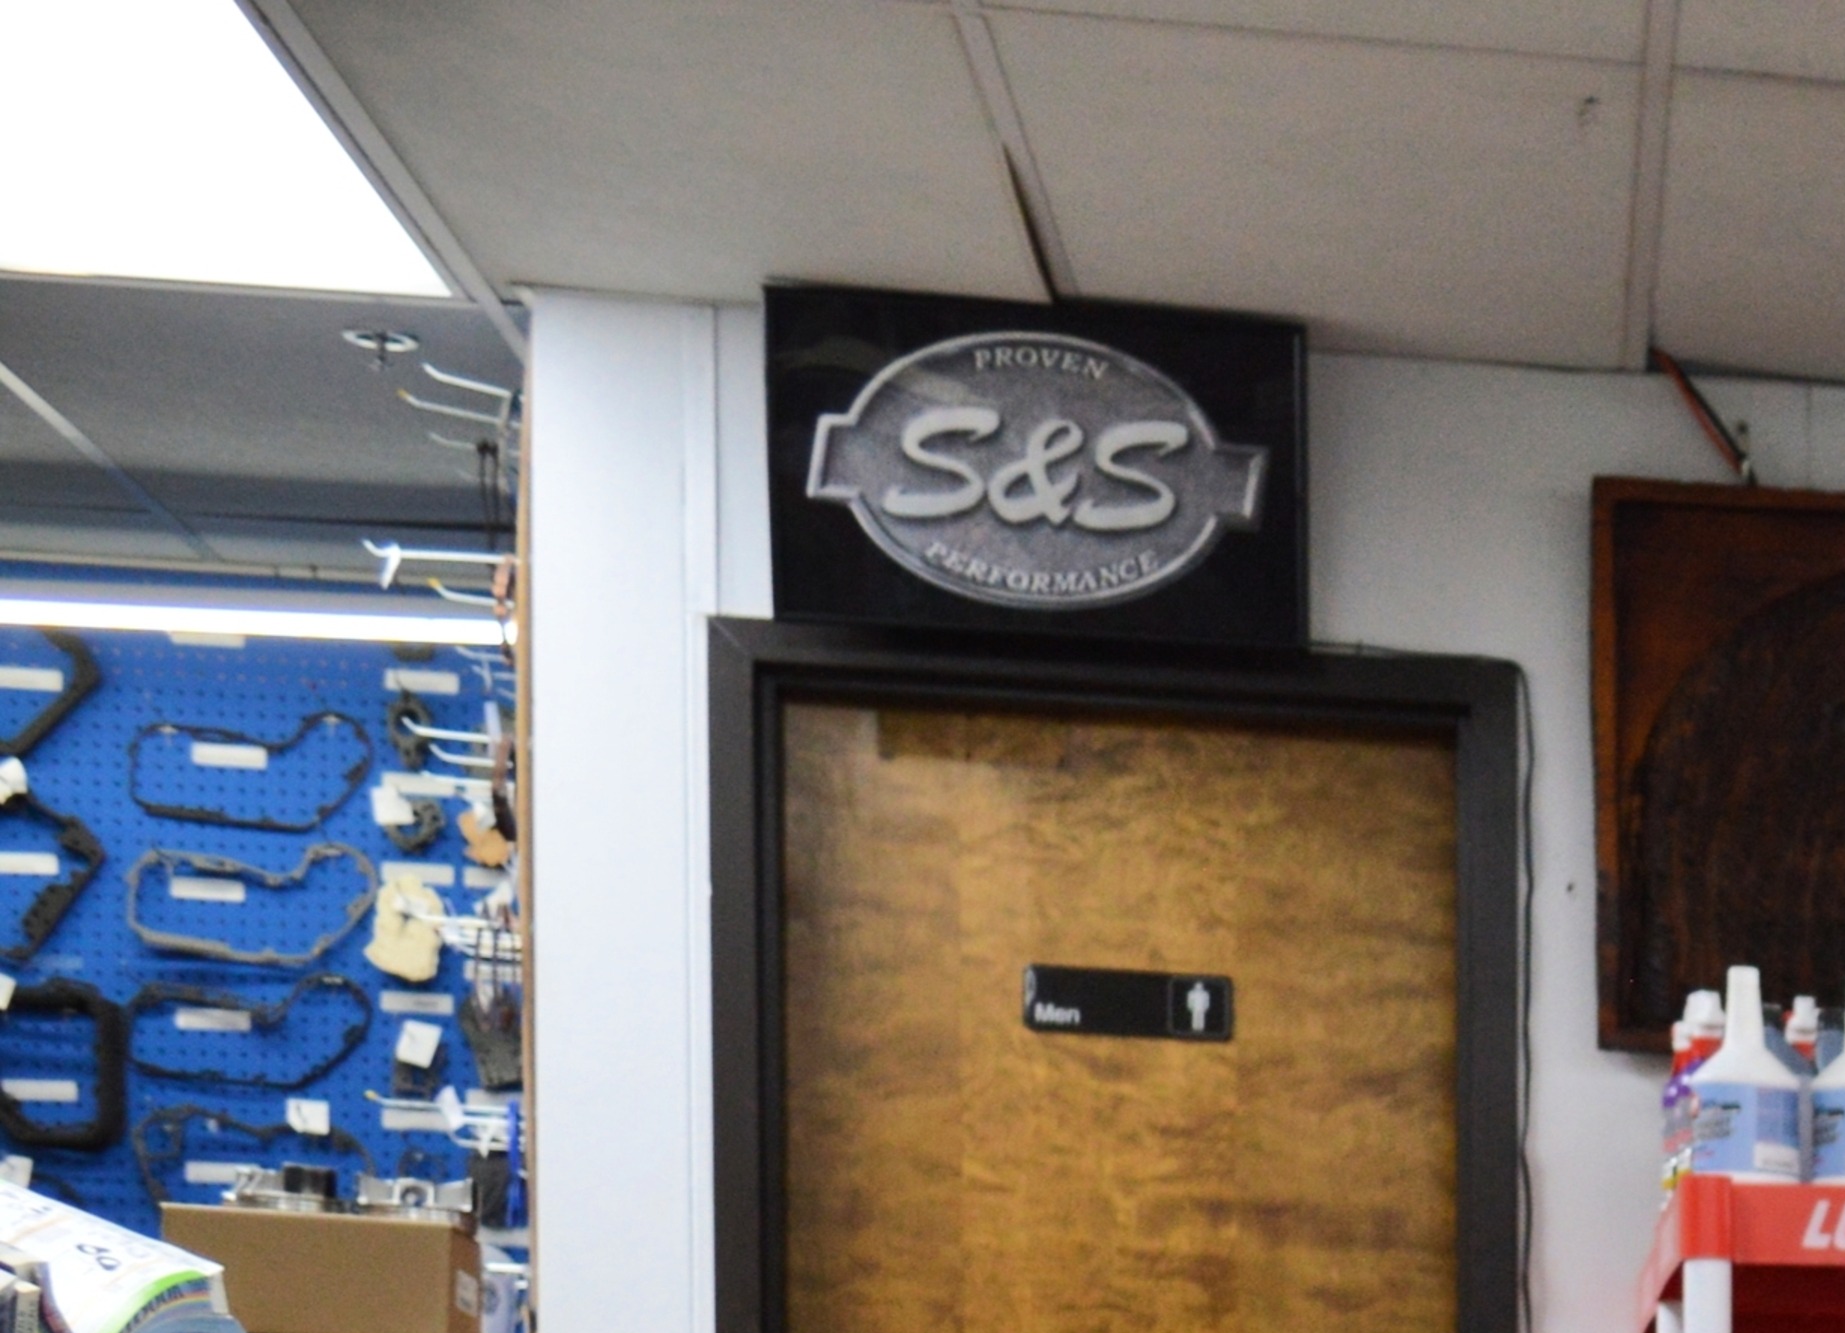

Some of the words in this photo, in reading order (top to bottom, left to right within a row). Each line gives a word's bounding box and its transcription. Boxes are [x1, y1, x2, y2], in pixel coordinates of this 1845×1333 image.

[973, 346, 1109, 380] PROVEN
[879, 407, 1189, 530] S&S
[925, 541, 1159, 594] PERFORMANCE
[1034, 1001, 1081, 1025] Men
